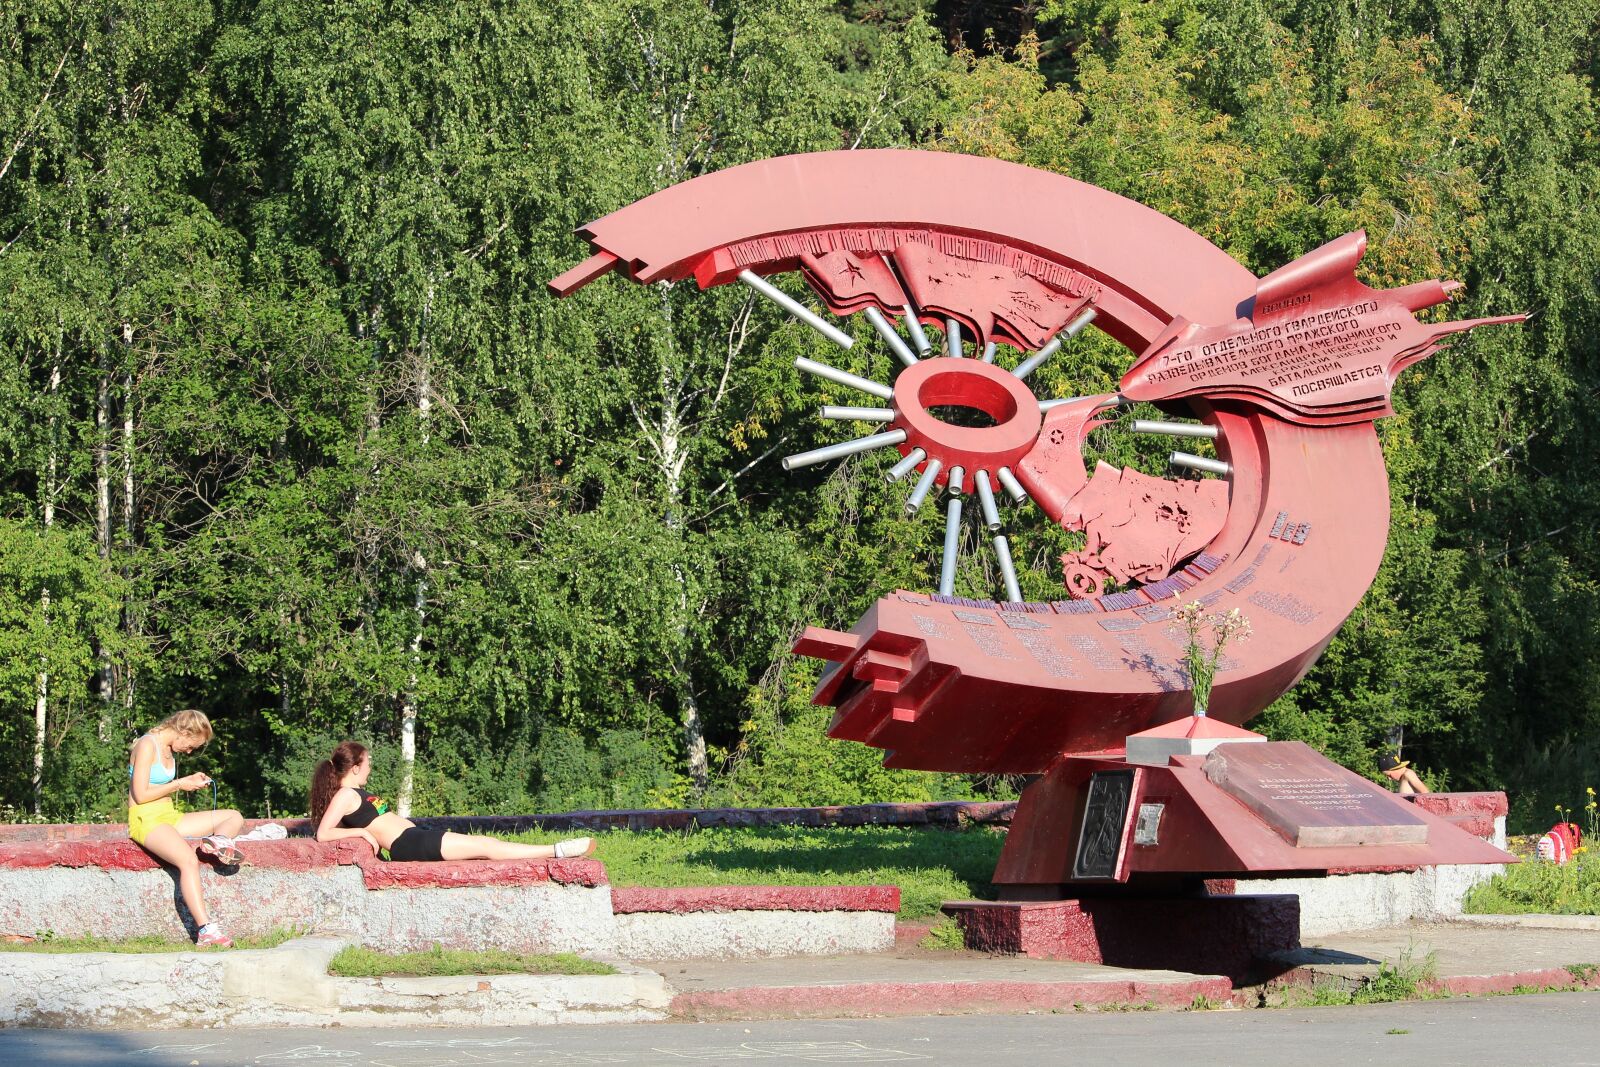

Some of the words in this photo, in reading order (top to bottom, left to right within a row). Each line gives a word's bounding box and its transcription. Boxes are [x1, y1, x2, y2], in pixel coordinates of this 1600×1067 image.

[1202, 326, 1281, 356] ОТДЕЛЬНОГО
[1287, 319, 1359, 345] ПРАЖСКОГО
[1189, 361, 1248, 382] ОРДЕНОВ
[1251, 345, 1307, 366] БОГДАНА
[1308, 321, 1402, 350] ХМЕЛЬНИЦКОГО
[1240, 352, 1320, 377] АЛЕКСАНДРА
[1387, 333, 1398, 341] И
[1268, 360, 1343, 387] БАТАЛЬОНА
[1292, 364, 1384, 397] ПОСВЯЩАЕТСЯ
